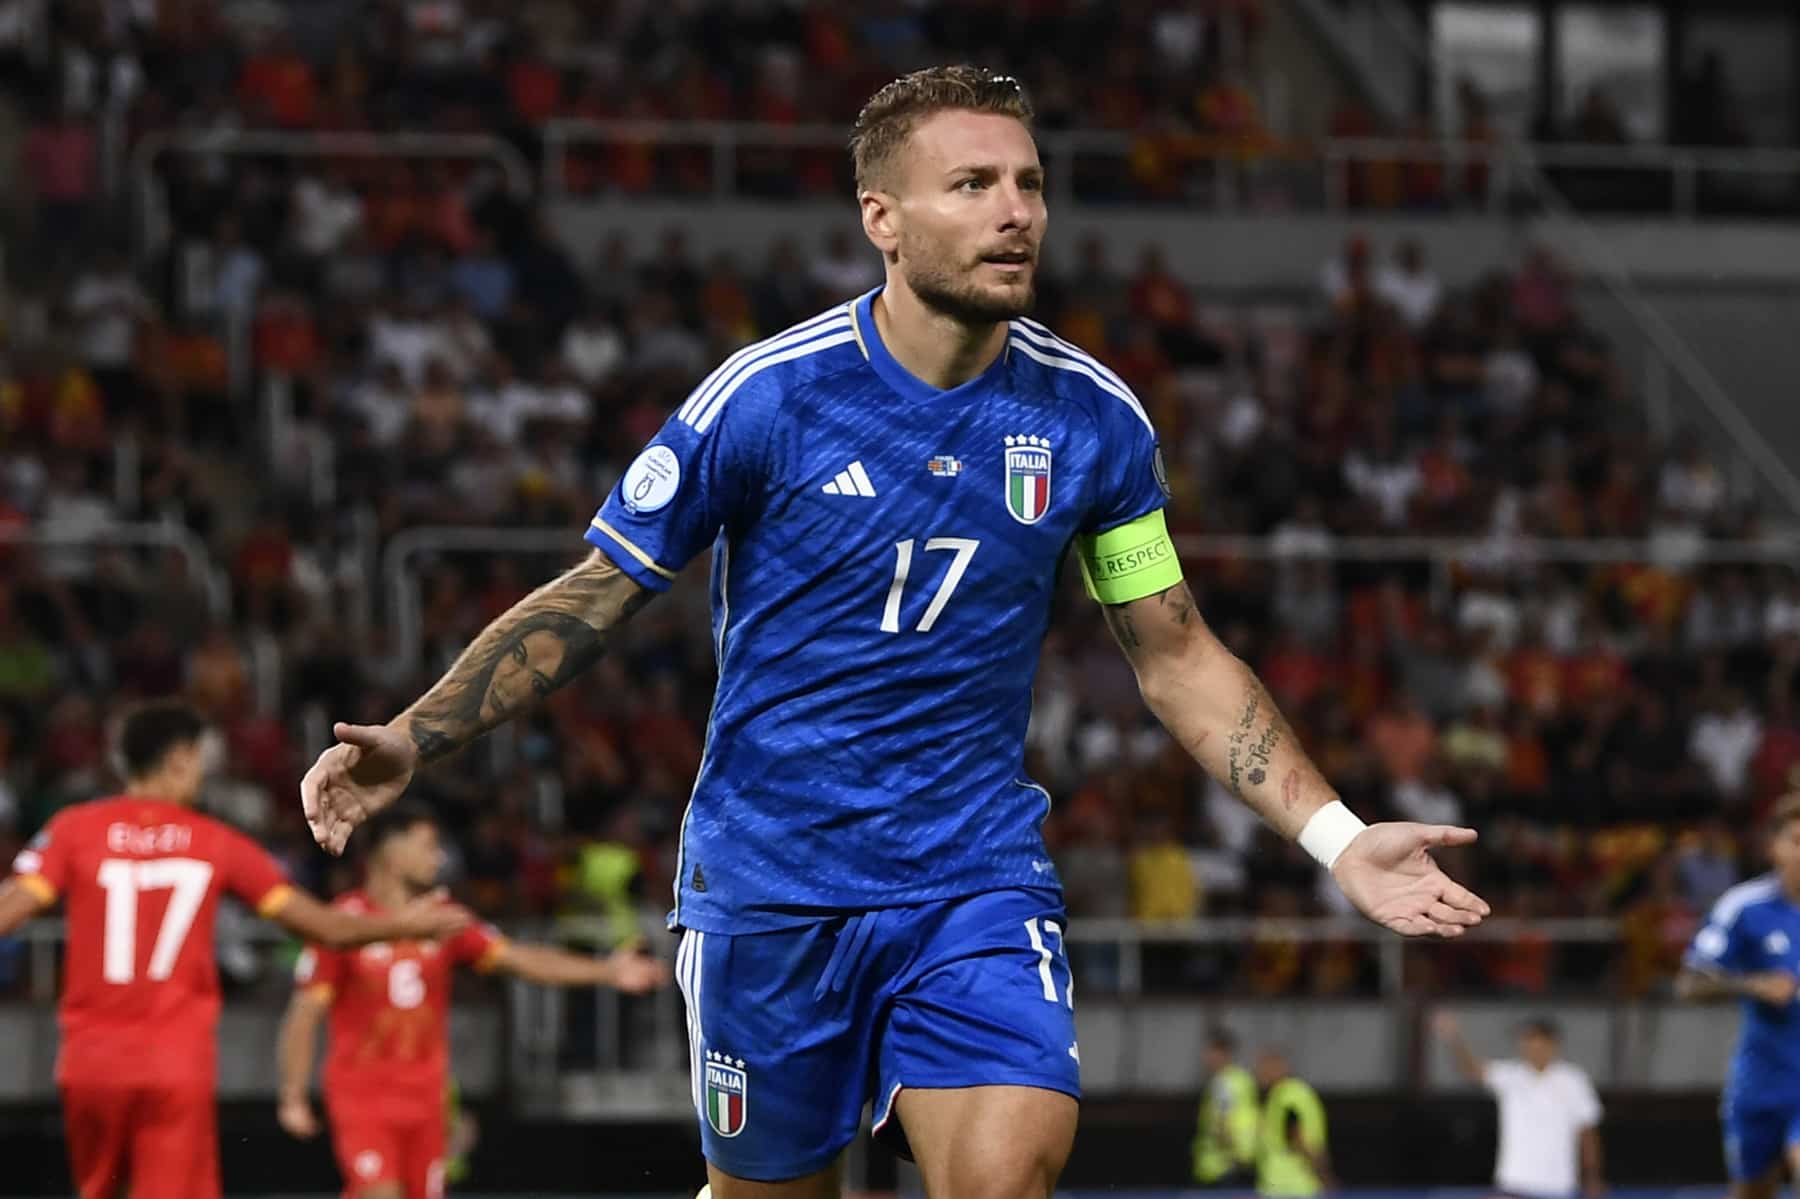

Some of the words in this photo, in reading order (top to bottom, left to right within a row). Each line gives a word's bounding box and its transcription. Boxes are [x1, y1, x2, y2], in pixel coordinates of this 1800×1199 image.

[1010, 454, 1048, 469] ITALIA
[880, 537, 980, 633] 17
[97, 858, 214, 984] 17
[388, 959, 426, 1008] 6
[708, 1068, 742, 1089] ITALIA
